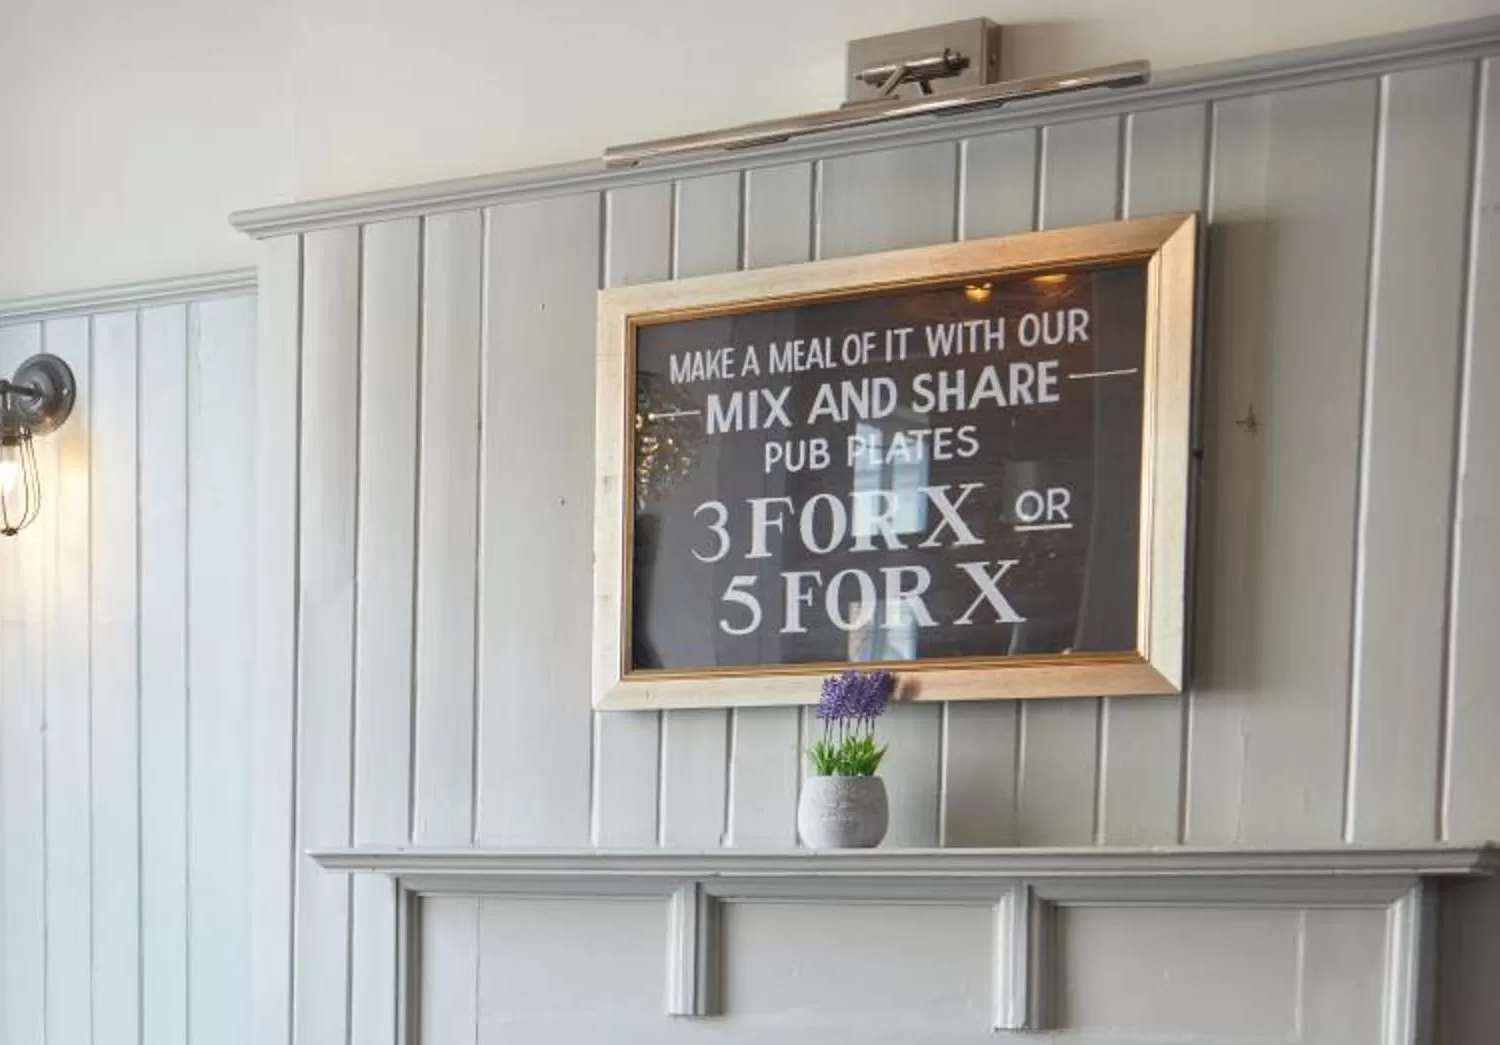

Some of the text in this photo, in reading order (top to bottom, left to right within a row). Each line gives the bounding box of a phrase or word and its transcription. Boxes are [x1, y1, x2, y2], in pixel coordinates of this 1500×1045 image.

[669, 308, 1090, 384] MAKE A MEAL OF IT WITH OUR
[706, 360, 1061, 435] MIX AND SHARE
[765, 425, 980, 474] PUB PLATES
[691, 482, 1072, 563] 3 FOR X OR
[719, 559, 1027, 635] 5 FOR X
